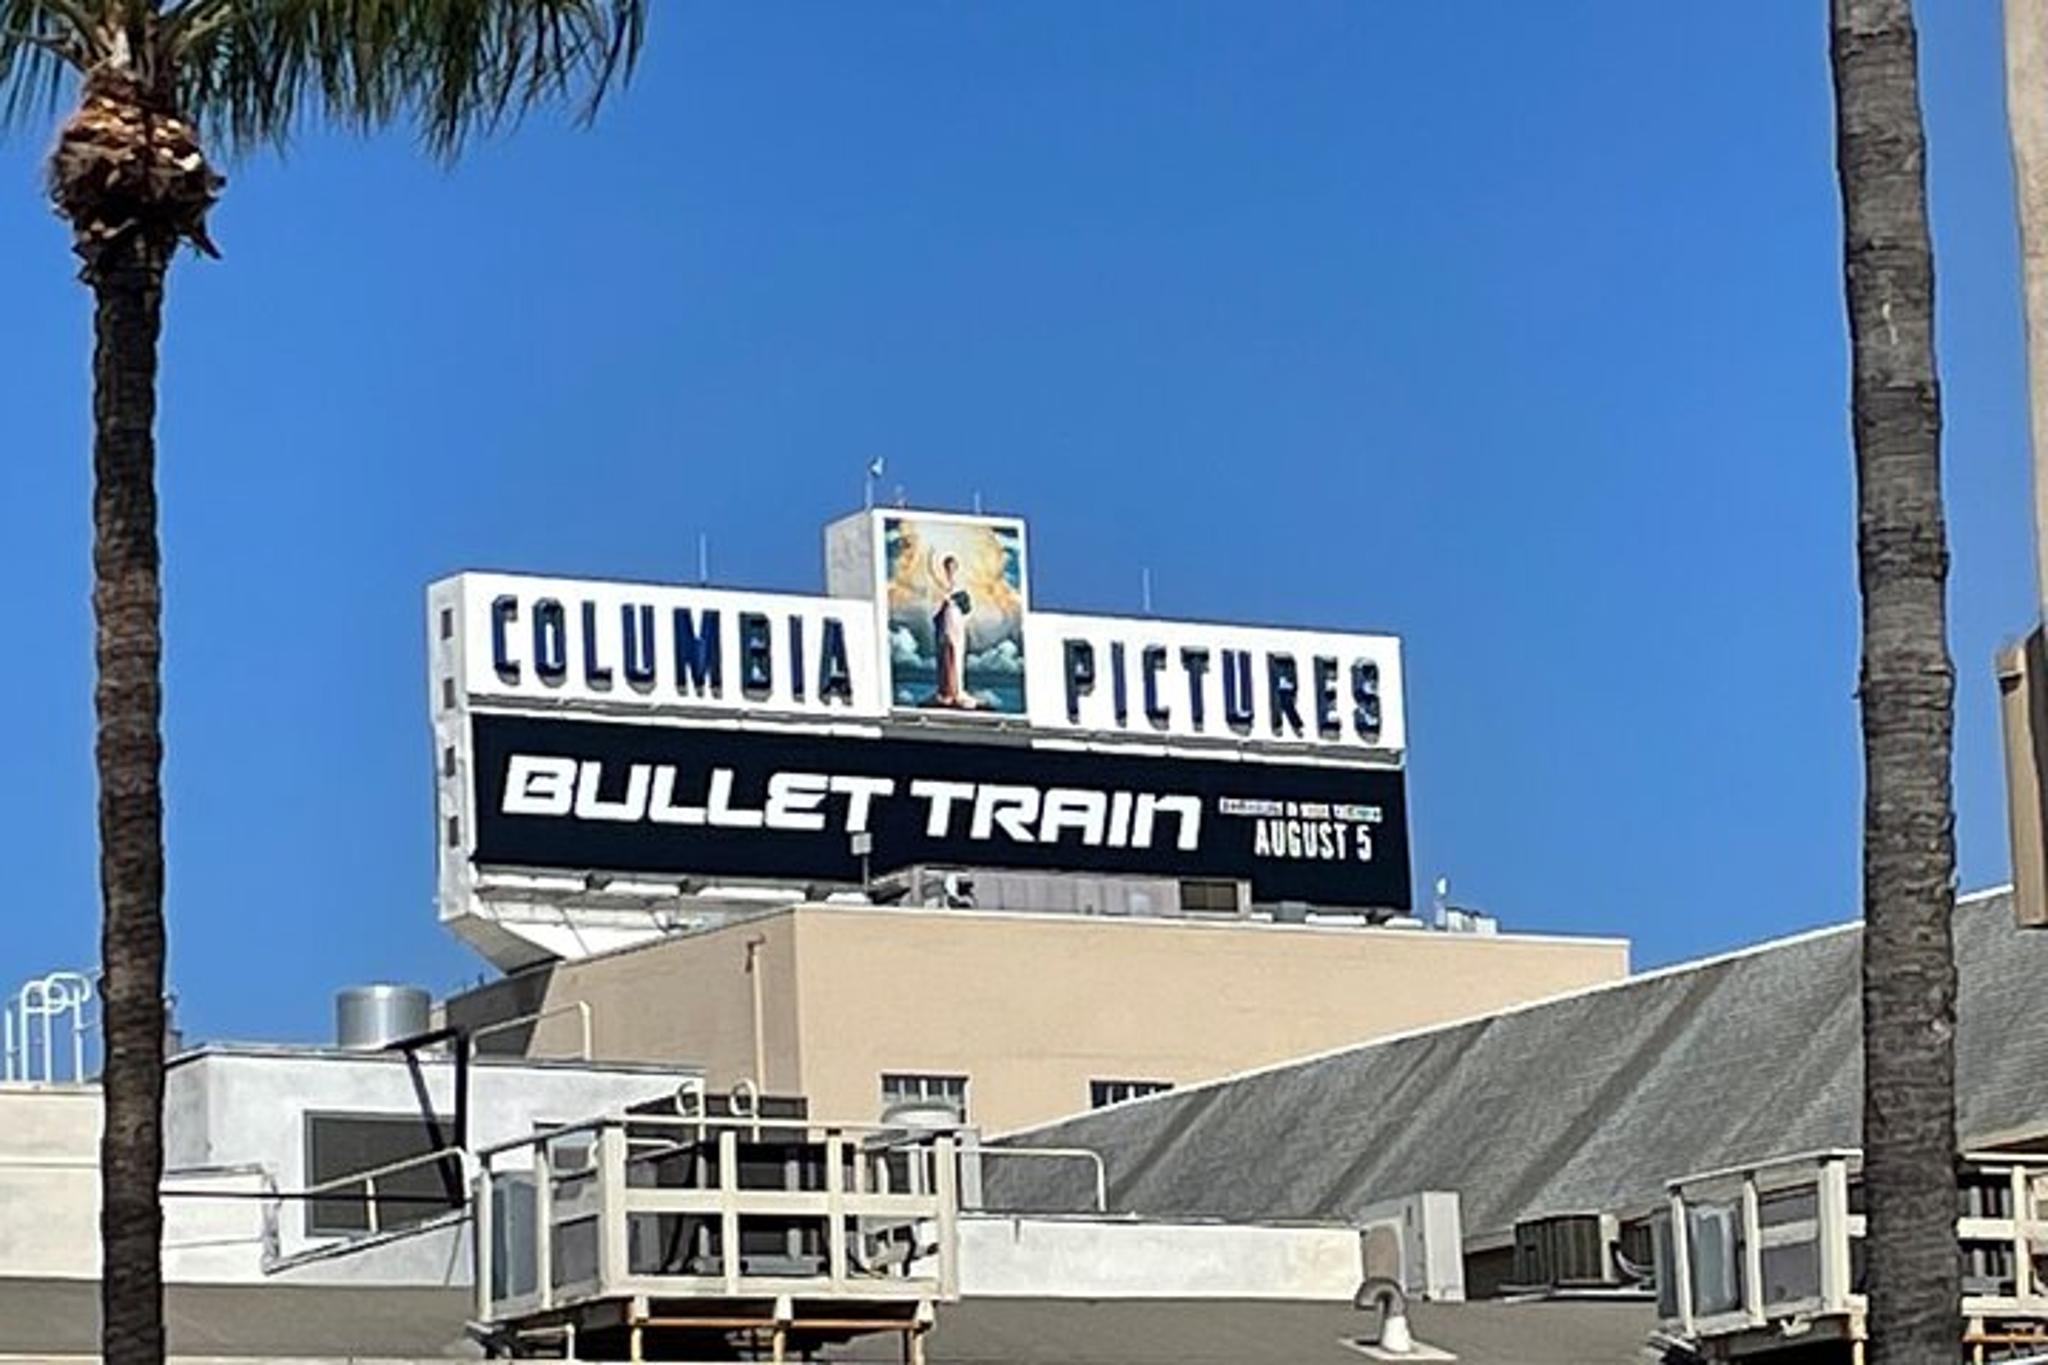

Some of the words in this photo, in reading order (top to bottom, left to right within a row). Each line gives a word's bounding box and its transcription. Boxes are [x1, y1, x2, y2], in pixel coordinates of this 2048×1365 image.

[491, 594, 854, 706] COLUMBIA
[1062, 638, 1383, 744] PICTURES
[502, 753, 895, 833] BULLET
[909, 779, 1202, 852] TRAIN
[1254, 818, 1348, 861] AUGUST
[1355, 824, 1373, 863] 5
